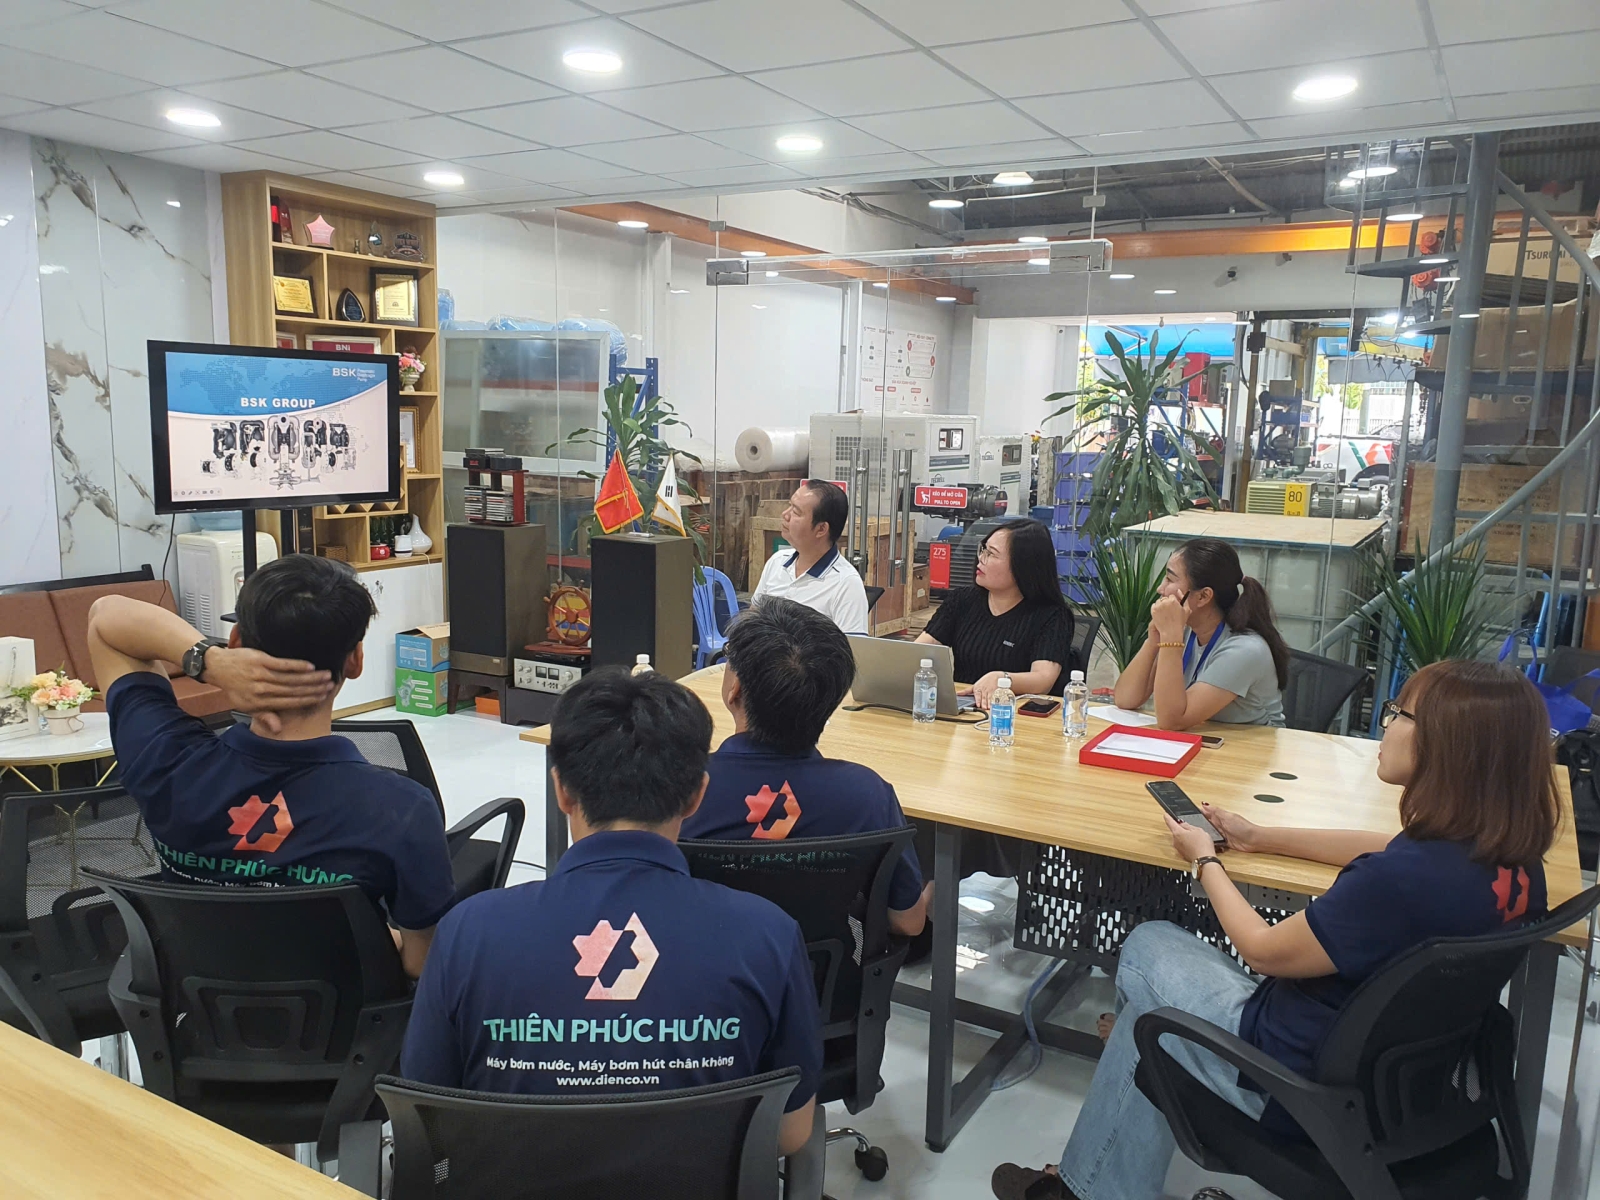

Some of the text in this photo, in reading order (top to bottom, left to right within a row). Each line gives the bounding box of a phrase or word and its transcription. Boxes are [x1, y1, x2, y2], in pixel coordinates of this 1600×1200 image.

[1525, 250, 1566, 260] TSURI
[332, 367, 357, 377] BSK
[240, 397, 316, 409] BSK GROUP
[1288, 490, 1303, 503] 80
[933, 547, 947, 556] 275
[154, 836, 216, 870] THIÊN
[483, 1012, 740, 1043] THIÊN PHÚC HƯNG
[486, 1055, 734, 1072] Máy bơm nước, Máy bơm hút chân không
[556, 1074, 660, 1086] www.dienco.vn
